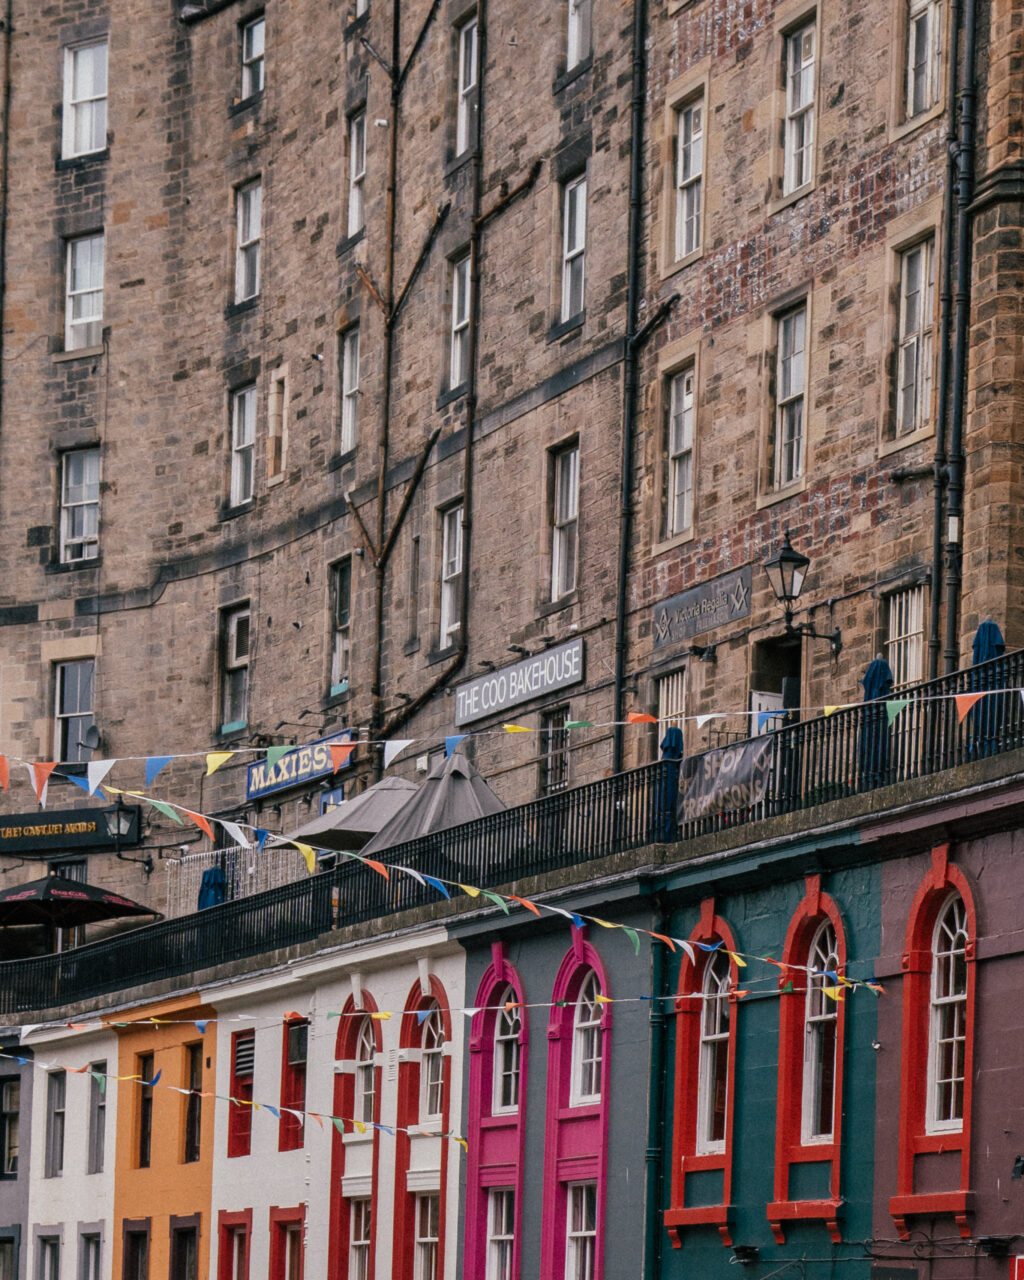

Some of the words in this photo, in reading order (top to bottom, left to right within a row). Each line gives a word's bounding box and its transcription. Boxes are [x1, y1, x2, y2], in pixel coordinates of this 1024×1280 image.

[701, 591, 729, 614] Regalia
[458, 686, 479, 718] THE
[481, 676, 507, 709] COO
[509, 646, 580, 699] BAKEHOUSE
[249, 743, 327, 792] MAXIES
